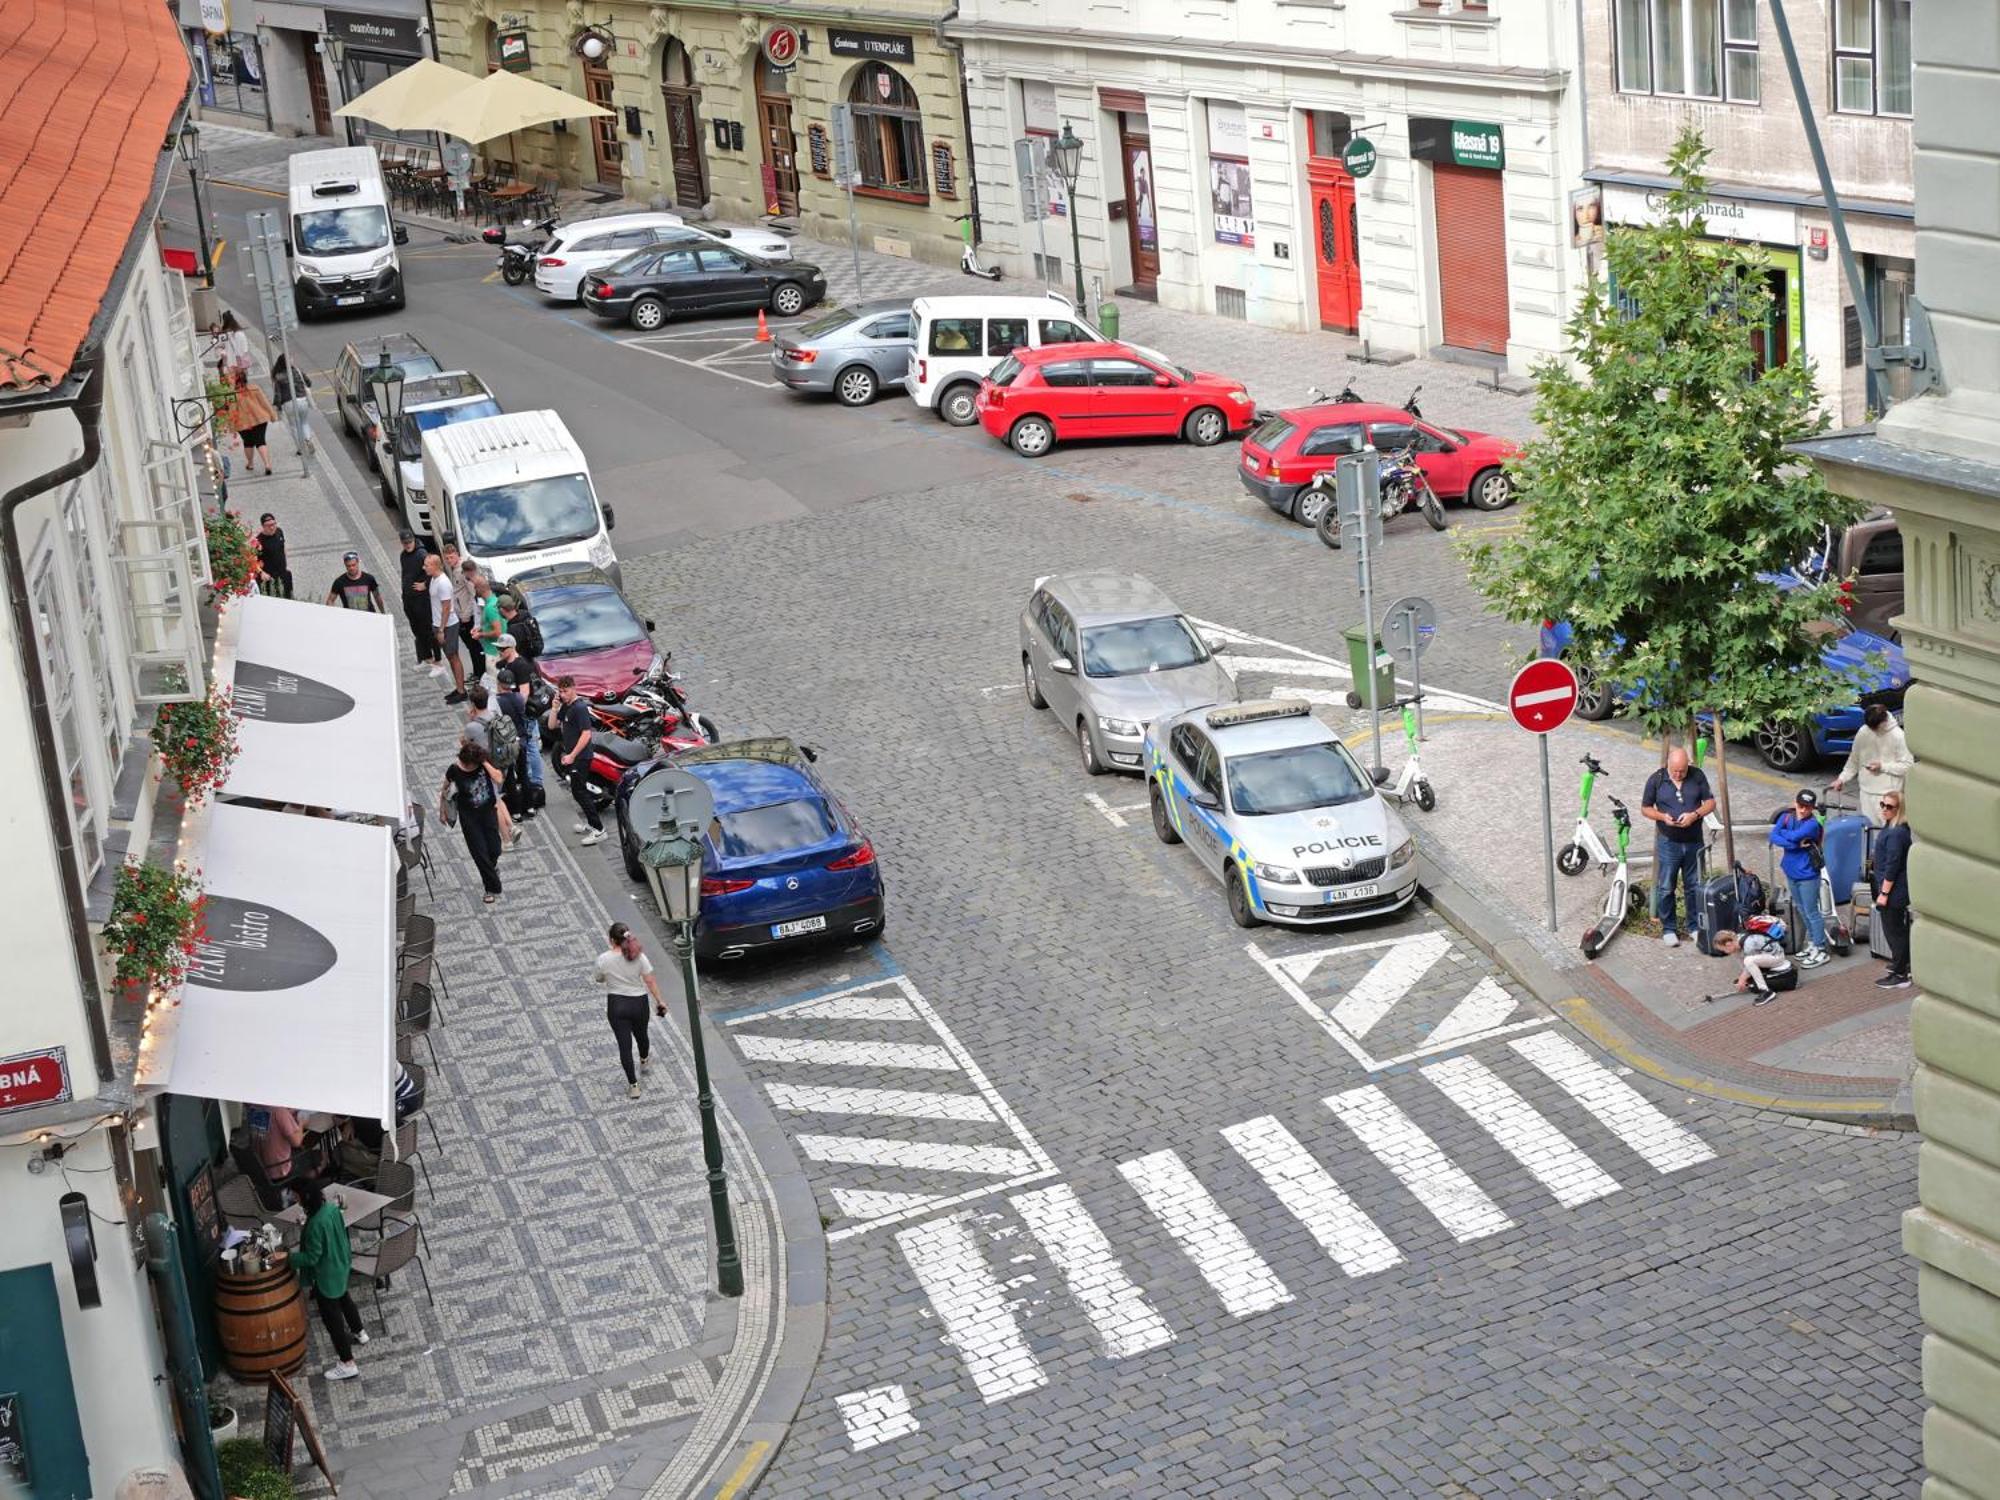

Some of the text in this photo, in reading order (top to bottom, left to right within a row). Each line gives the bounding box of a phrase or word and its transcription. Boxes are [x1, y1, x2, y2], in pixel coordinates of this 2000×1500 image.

[1454, 131, 1499, 153] Masná 19
[1293, 835, 1383, 858] POLICIE
[224, 911, 269, 950] bistro
